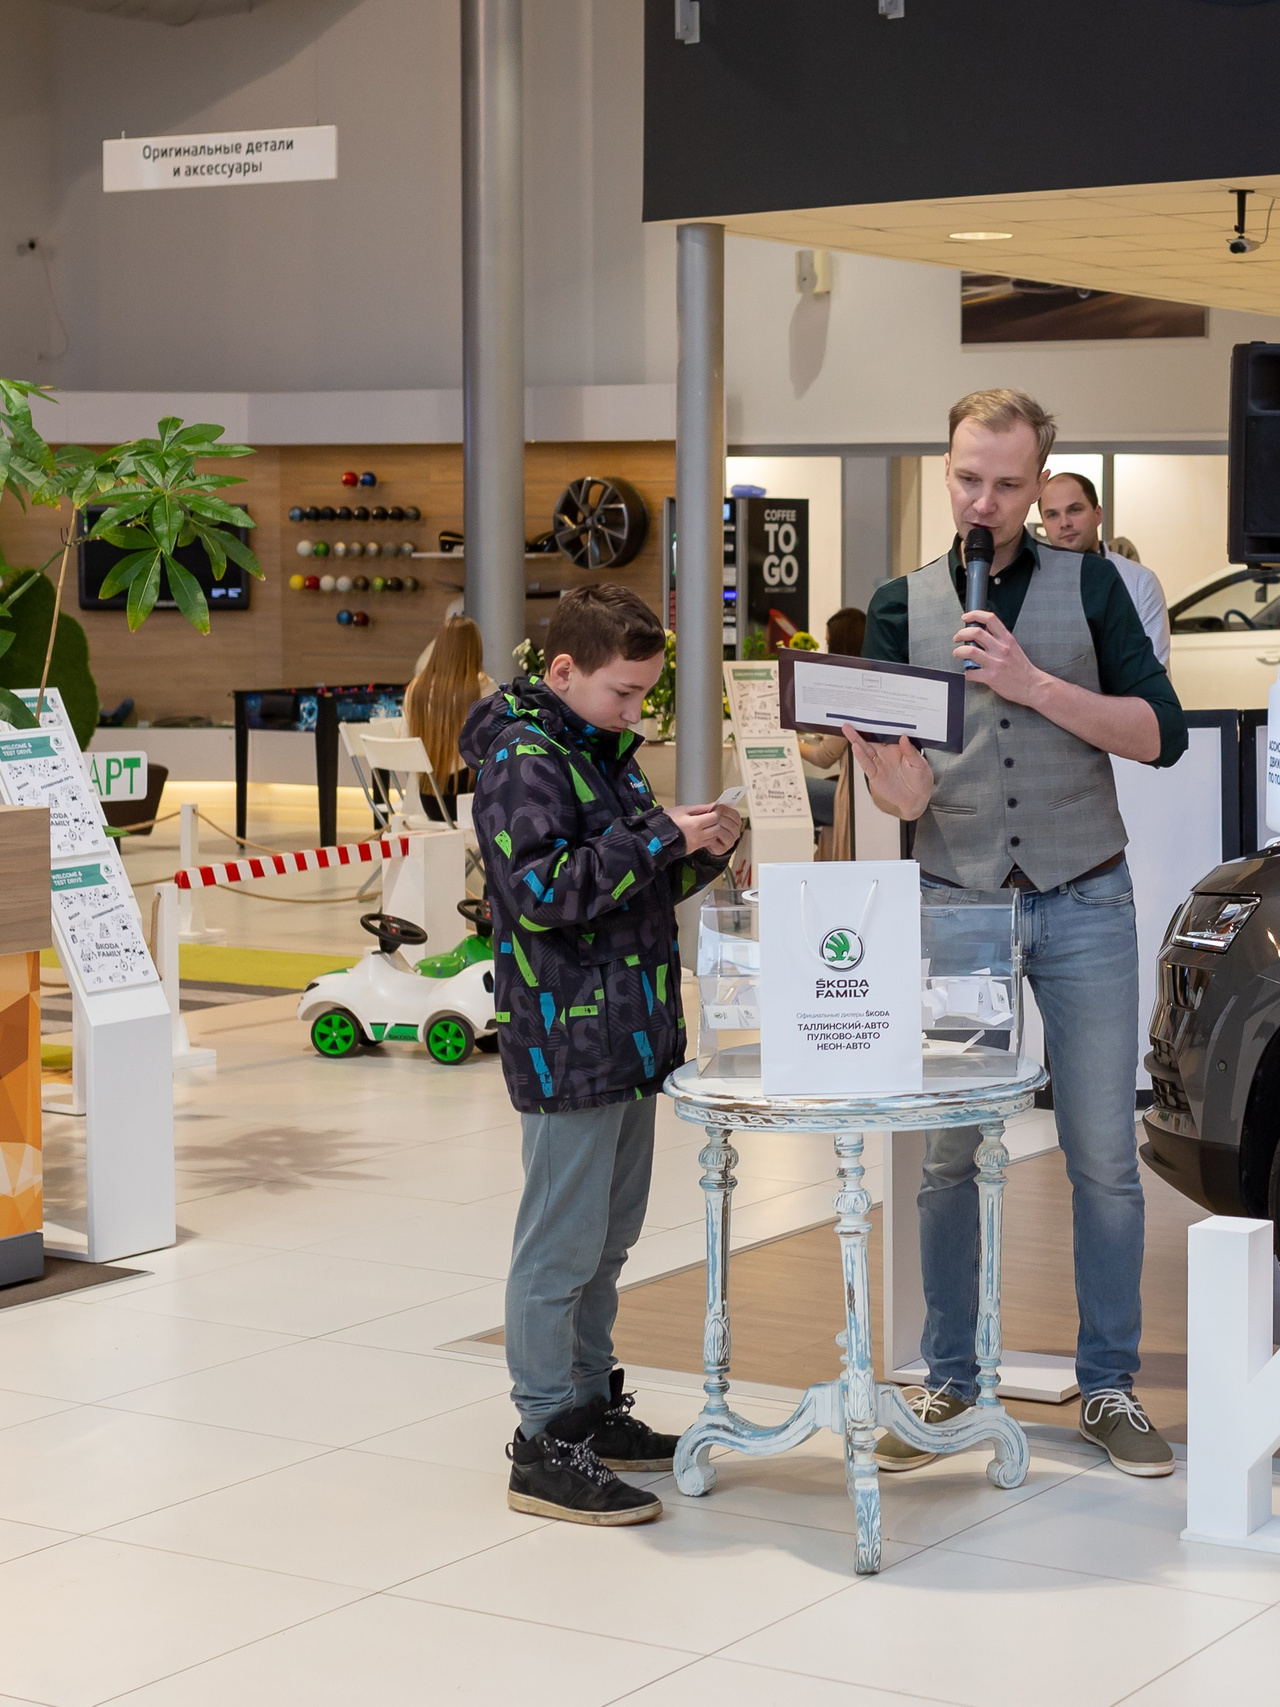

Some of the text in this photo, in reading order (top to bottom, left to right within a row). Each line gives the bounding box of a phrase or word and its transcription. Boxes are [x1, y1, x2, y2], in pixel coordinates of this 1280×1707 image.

[142, 139, 294, 162] Оригинальные детали
[173, 160, 263, 178] и аксессуары
[764, 509, 797, 522] COFFEE
[764, 523, 797, 554] TO
[763, 554, 799, 586] GO
[90, 757, 141, 796] АРТ
[816, 978, 870, 988] ŠKODA
[816, 989, 870, 998] FAMILY
[797, 1021, 890, 1031] ТАЛЛИНСКИЙ-АВТО
[807, 1032, 880, 1041] ПУЛКОВО-АВТО
[817, 1042, 871, 1051] НЕОН-АВТО
